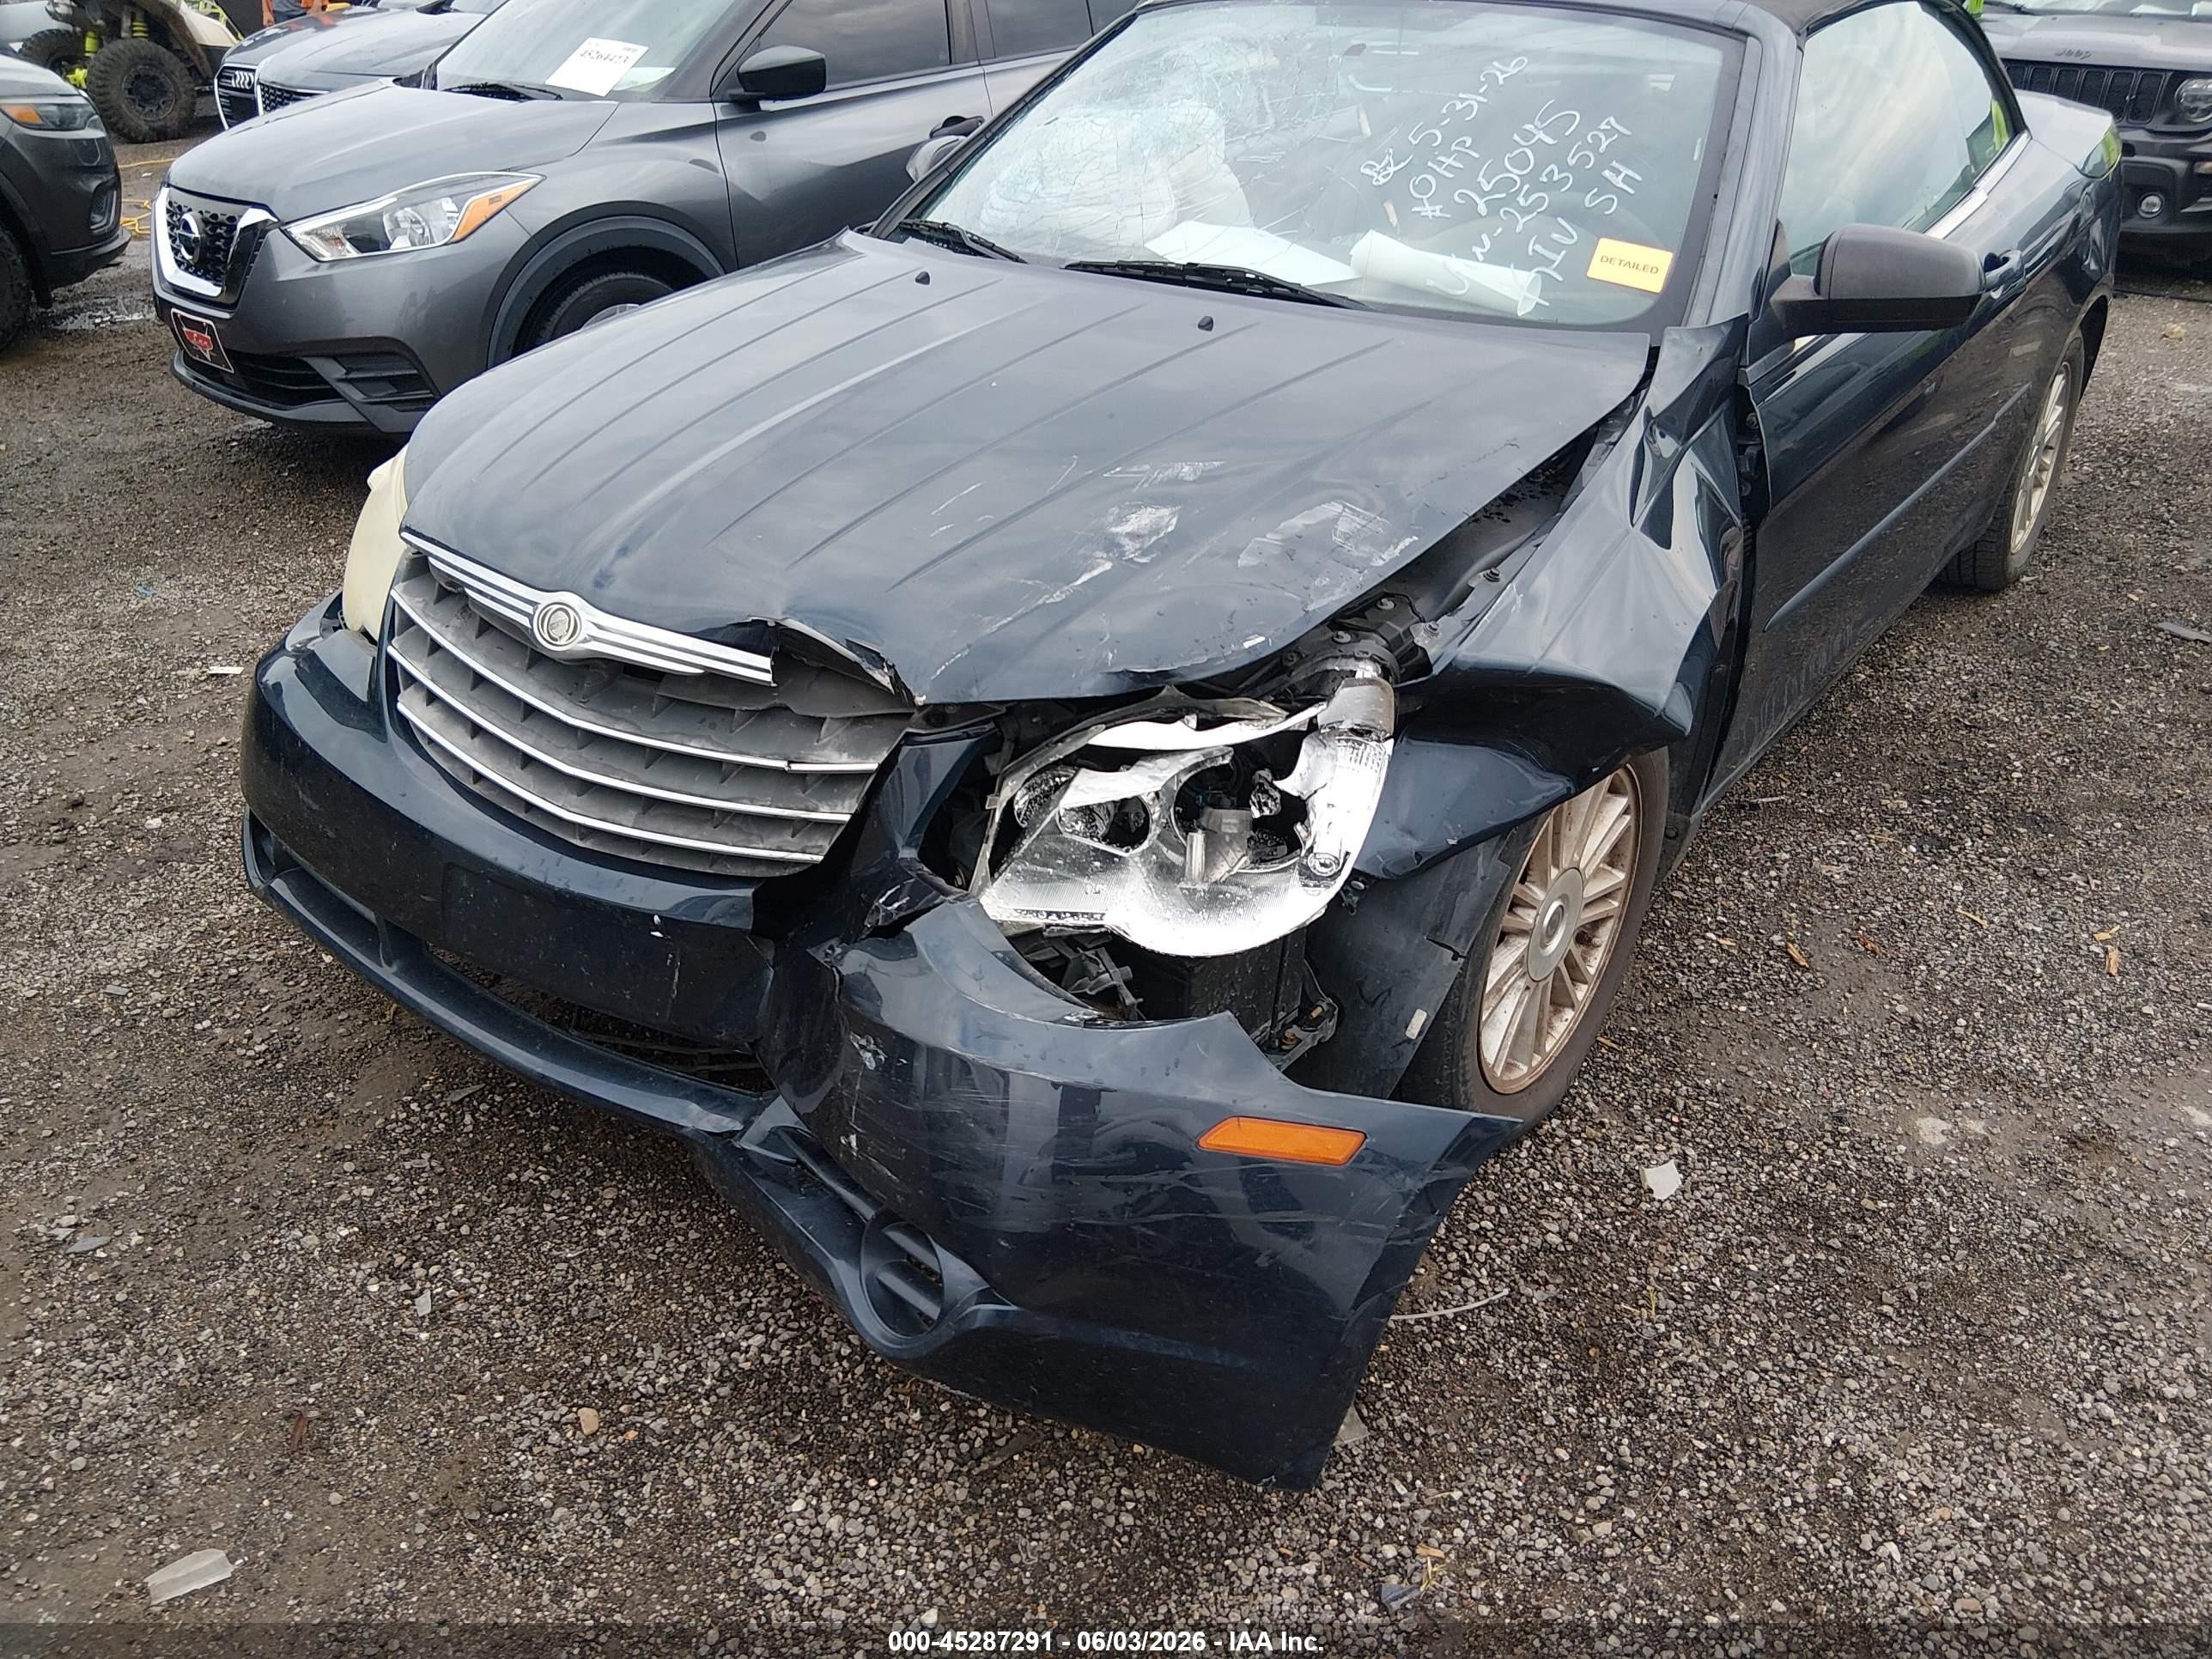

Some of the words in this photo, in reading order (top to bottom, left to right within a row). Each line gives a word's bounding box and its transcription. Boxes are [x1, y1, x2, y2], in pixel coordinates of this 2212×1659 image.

[2056, 49, 2092, 60] Jeep
[1408, 57, 1528, 148] 5-31-26
[1600, 254, 1660, 276] DETAILED
